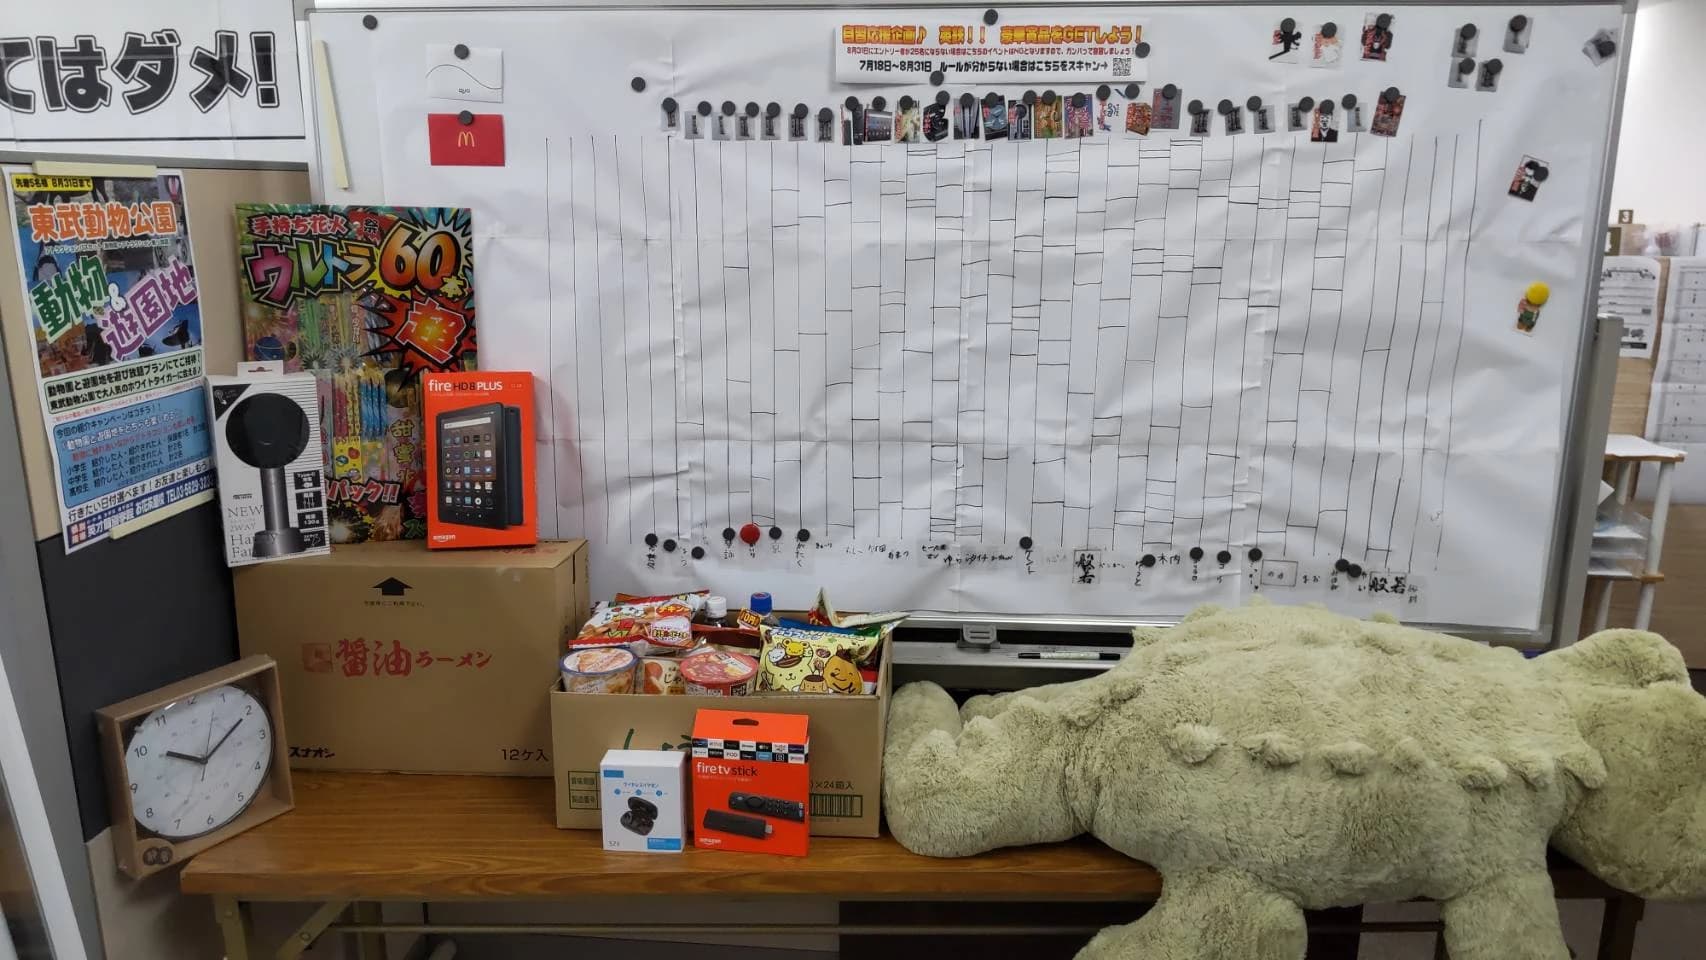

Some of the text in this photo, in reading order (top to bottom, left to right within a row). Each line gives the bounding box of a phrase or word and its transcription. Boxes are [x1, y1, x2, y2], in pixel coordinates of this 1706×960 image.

[28, 201, 177, 242] 東武動物公園
[252, 214, 348, 236] 手持ち花火
[248, 241, 375, 306] ウルトラ
[30, 255, 111, 342] 動物
[102, 256, 198, 361] 遊園地
[428, 379, 451, 391] fire
[476, 381, 503, 391] PLUS
[325, 480, 401, 503] パック!!
[432, 533, 456, 542] amazon
[1158, 552, 1181, 565] 木内
[335, 638, 493, 677] 醤油ラーメン
[246, 705, 253, 715] 2
[259, 730, 266, 739] 3
[134, 745, 148, 758] 10
[254, 761, 261, 770] 4
[732, 765, 758, 777] stick
[237, 792, 244, 802] 5
[145, 808, 154, 818] 8
